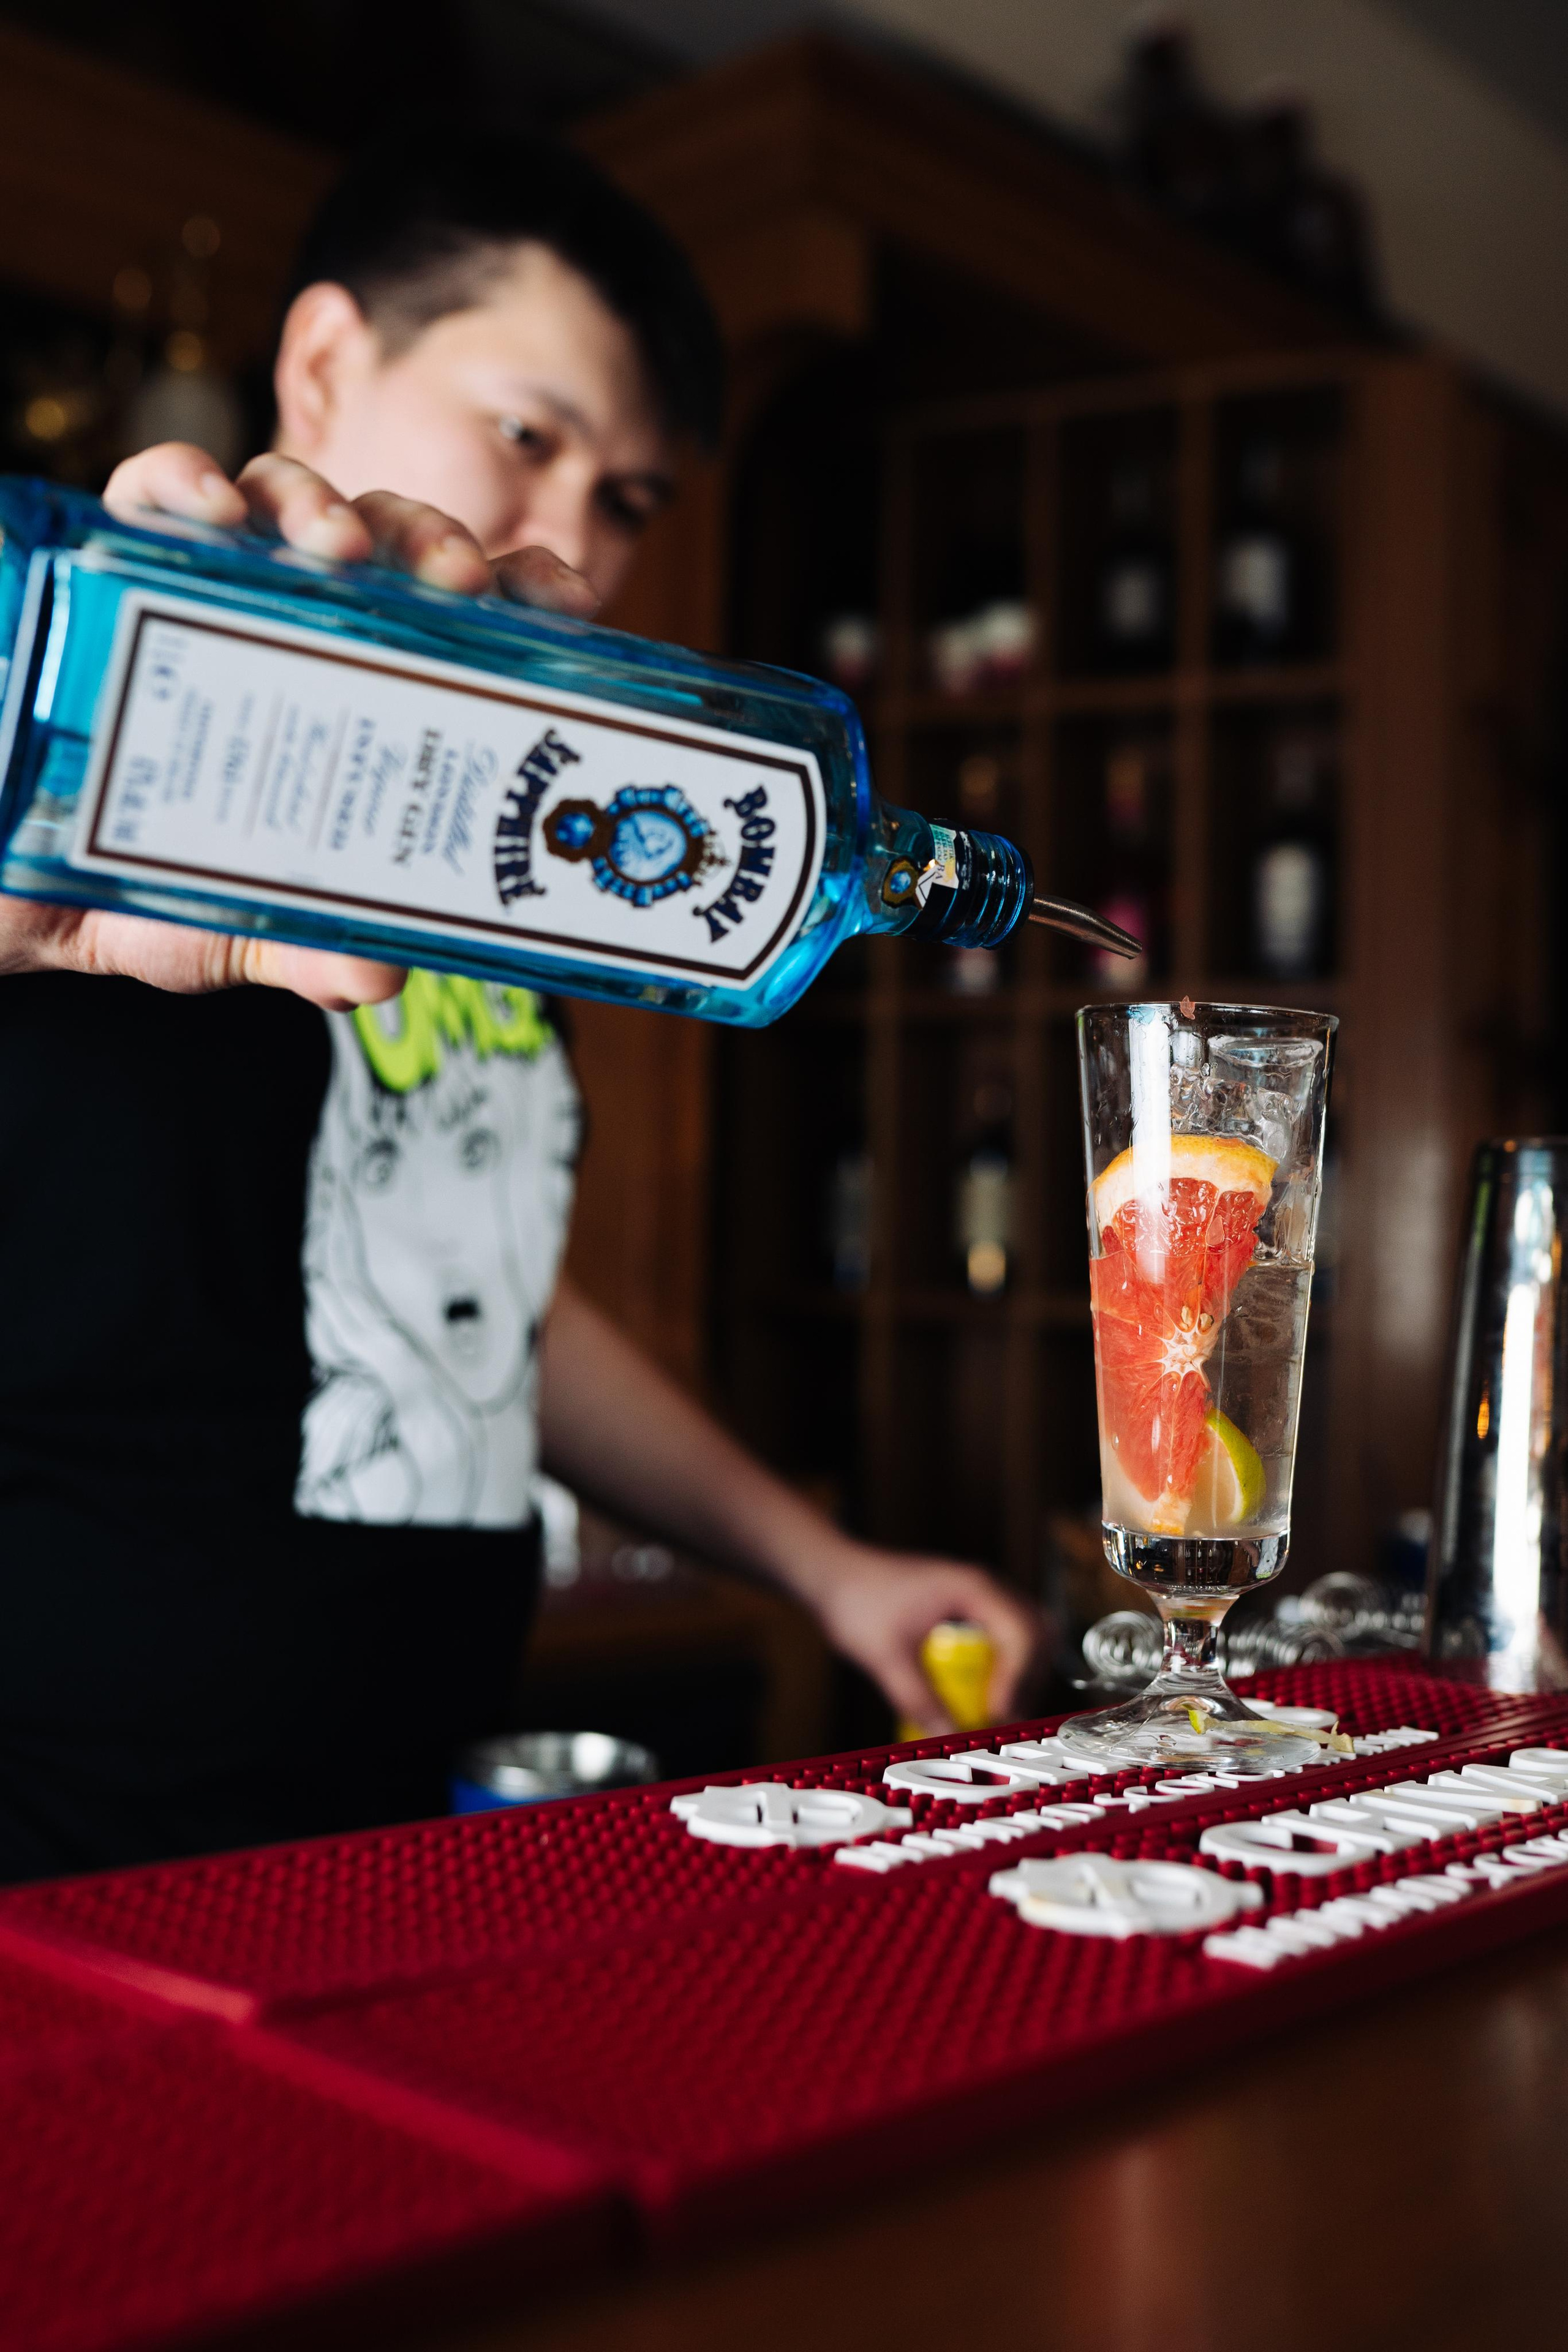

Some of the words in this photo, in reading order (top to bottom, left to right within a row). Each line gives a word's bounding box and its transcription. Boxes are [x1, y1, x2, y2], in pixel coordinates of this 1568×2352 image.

[494, 727, 582, 907] SAPPHIRE
[693, 785, 777, 943] BOMBAY
[1444, 1828, 1568, 1890] SCOT
